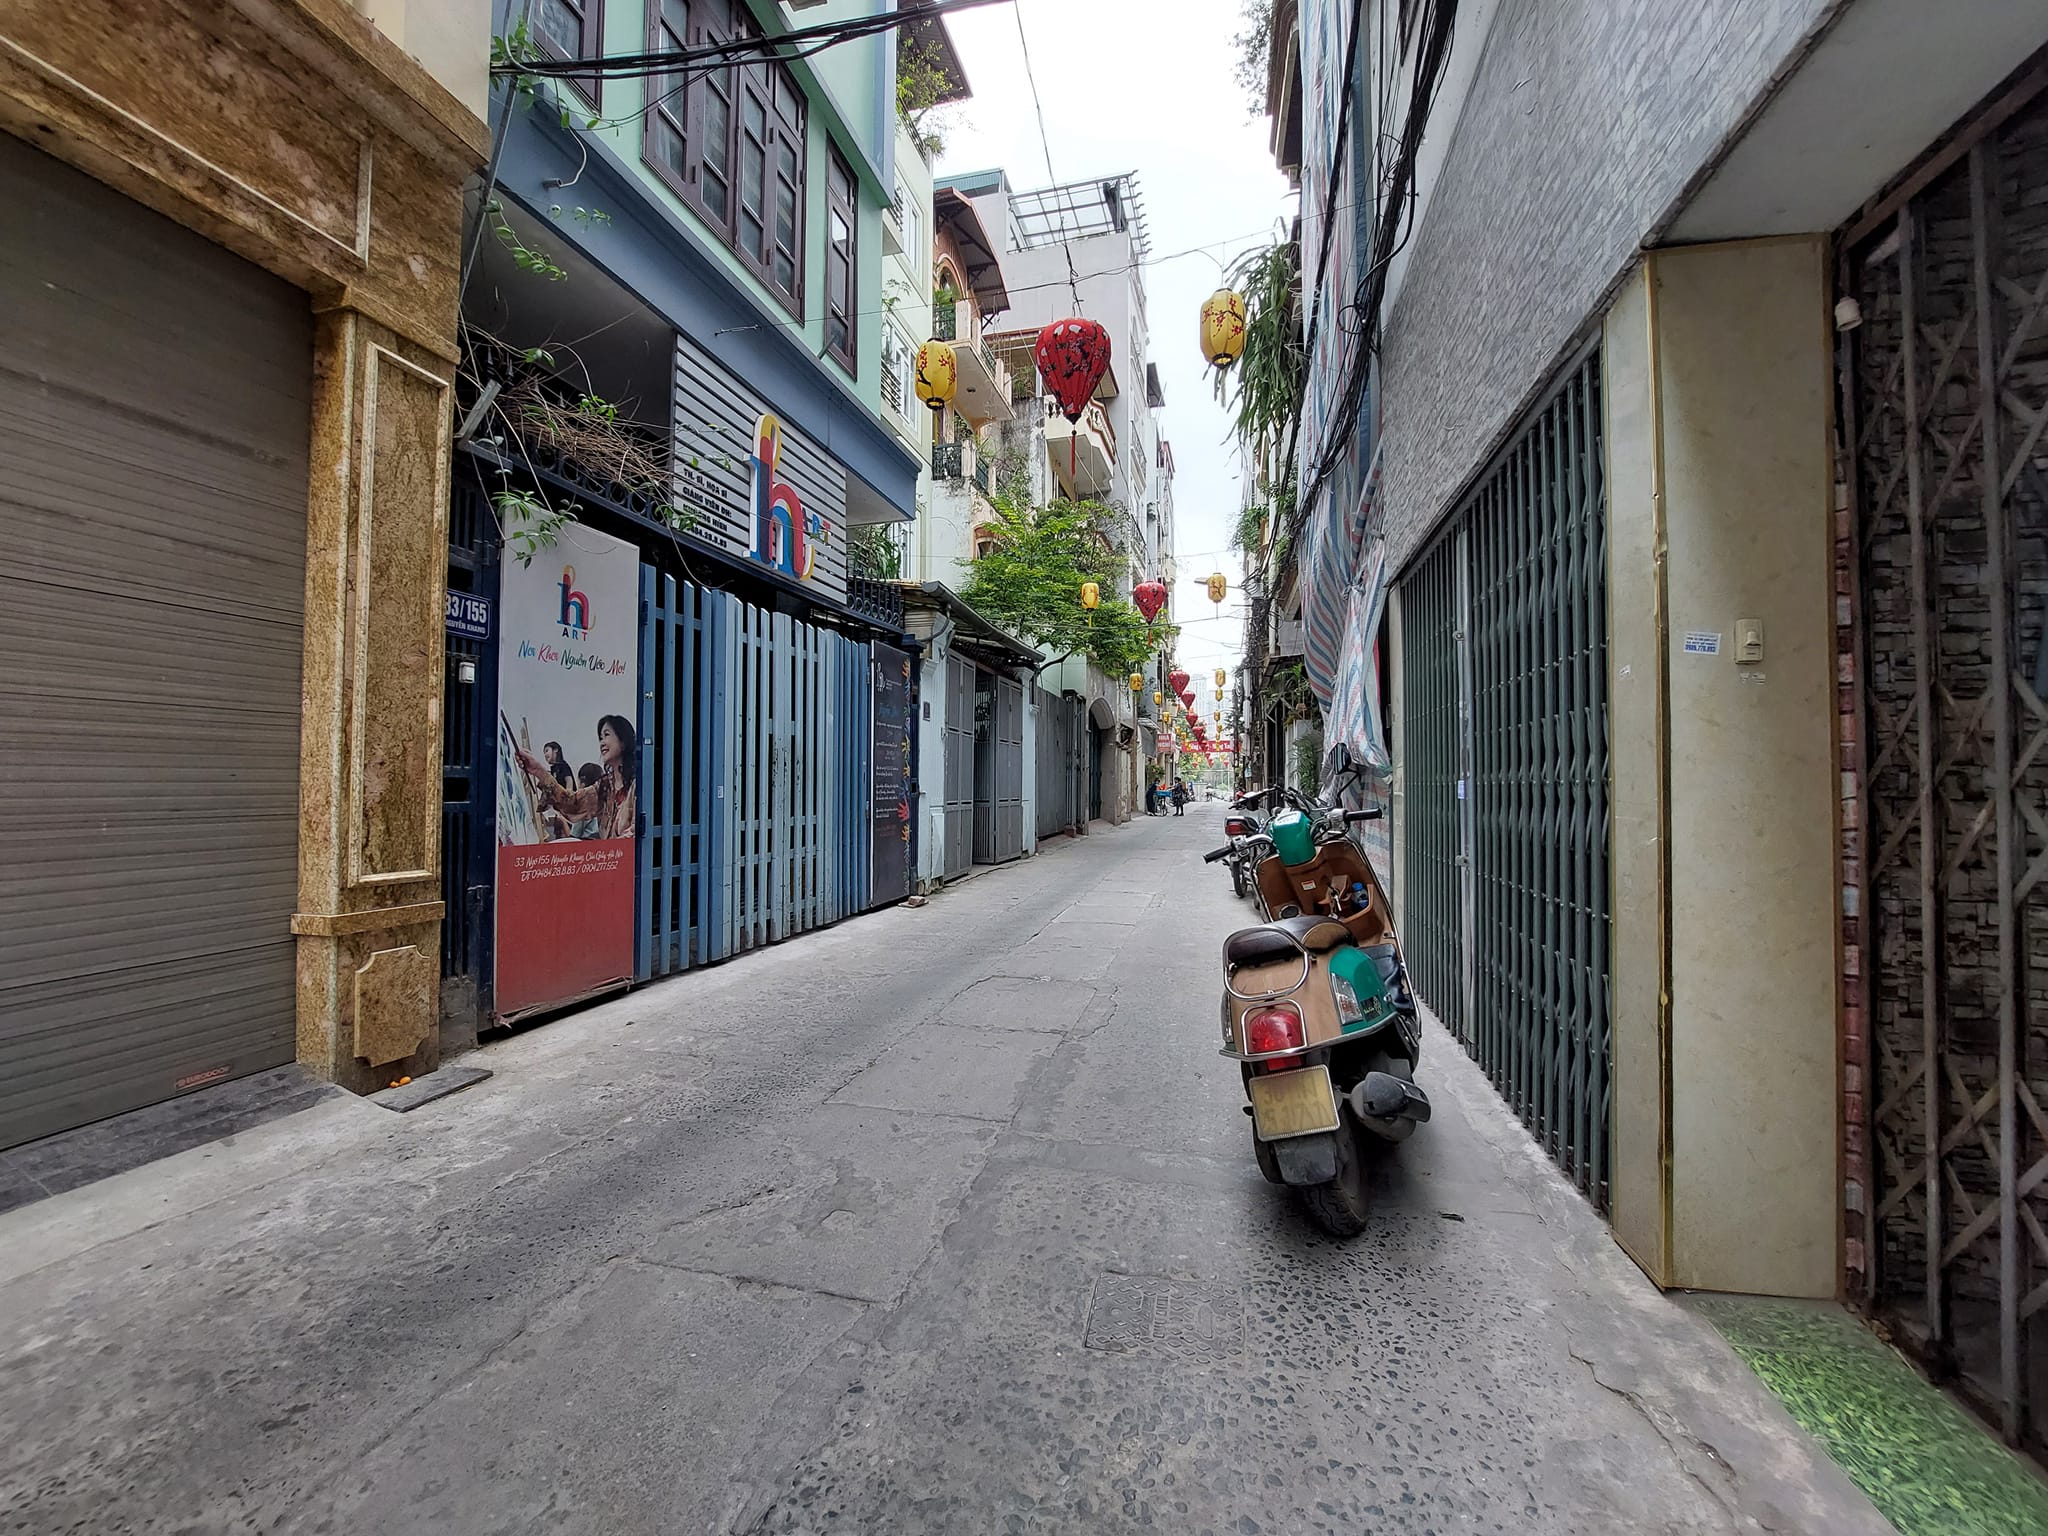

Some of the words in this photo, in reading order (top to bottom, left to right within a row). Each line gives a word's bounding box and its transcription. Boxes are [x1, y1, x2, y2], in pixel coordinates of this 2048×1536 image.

[445, 594, 488, 624] 33/155
[562, 627, 588, 641] ART
[514, 857, 525, 868] 33
[538, 854, 550, 865] 155
